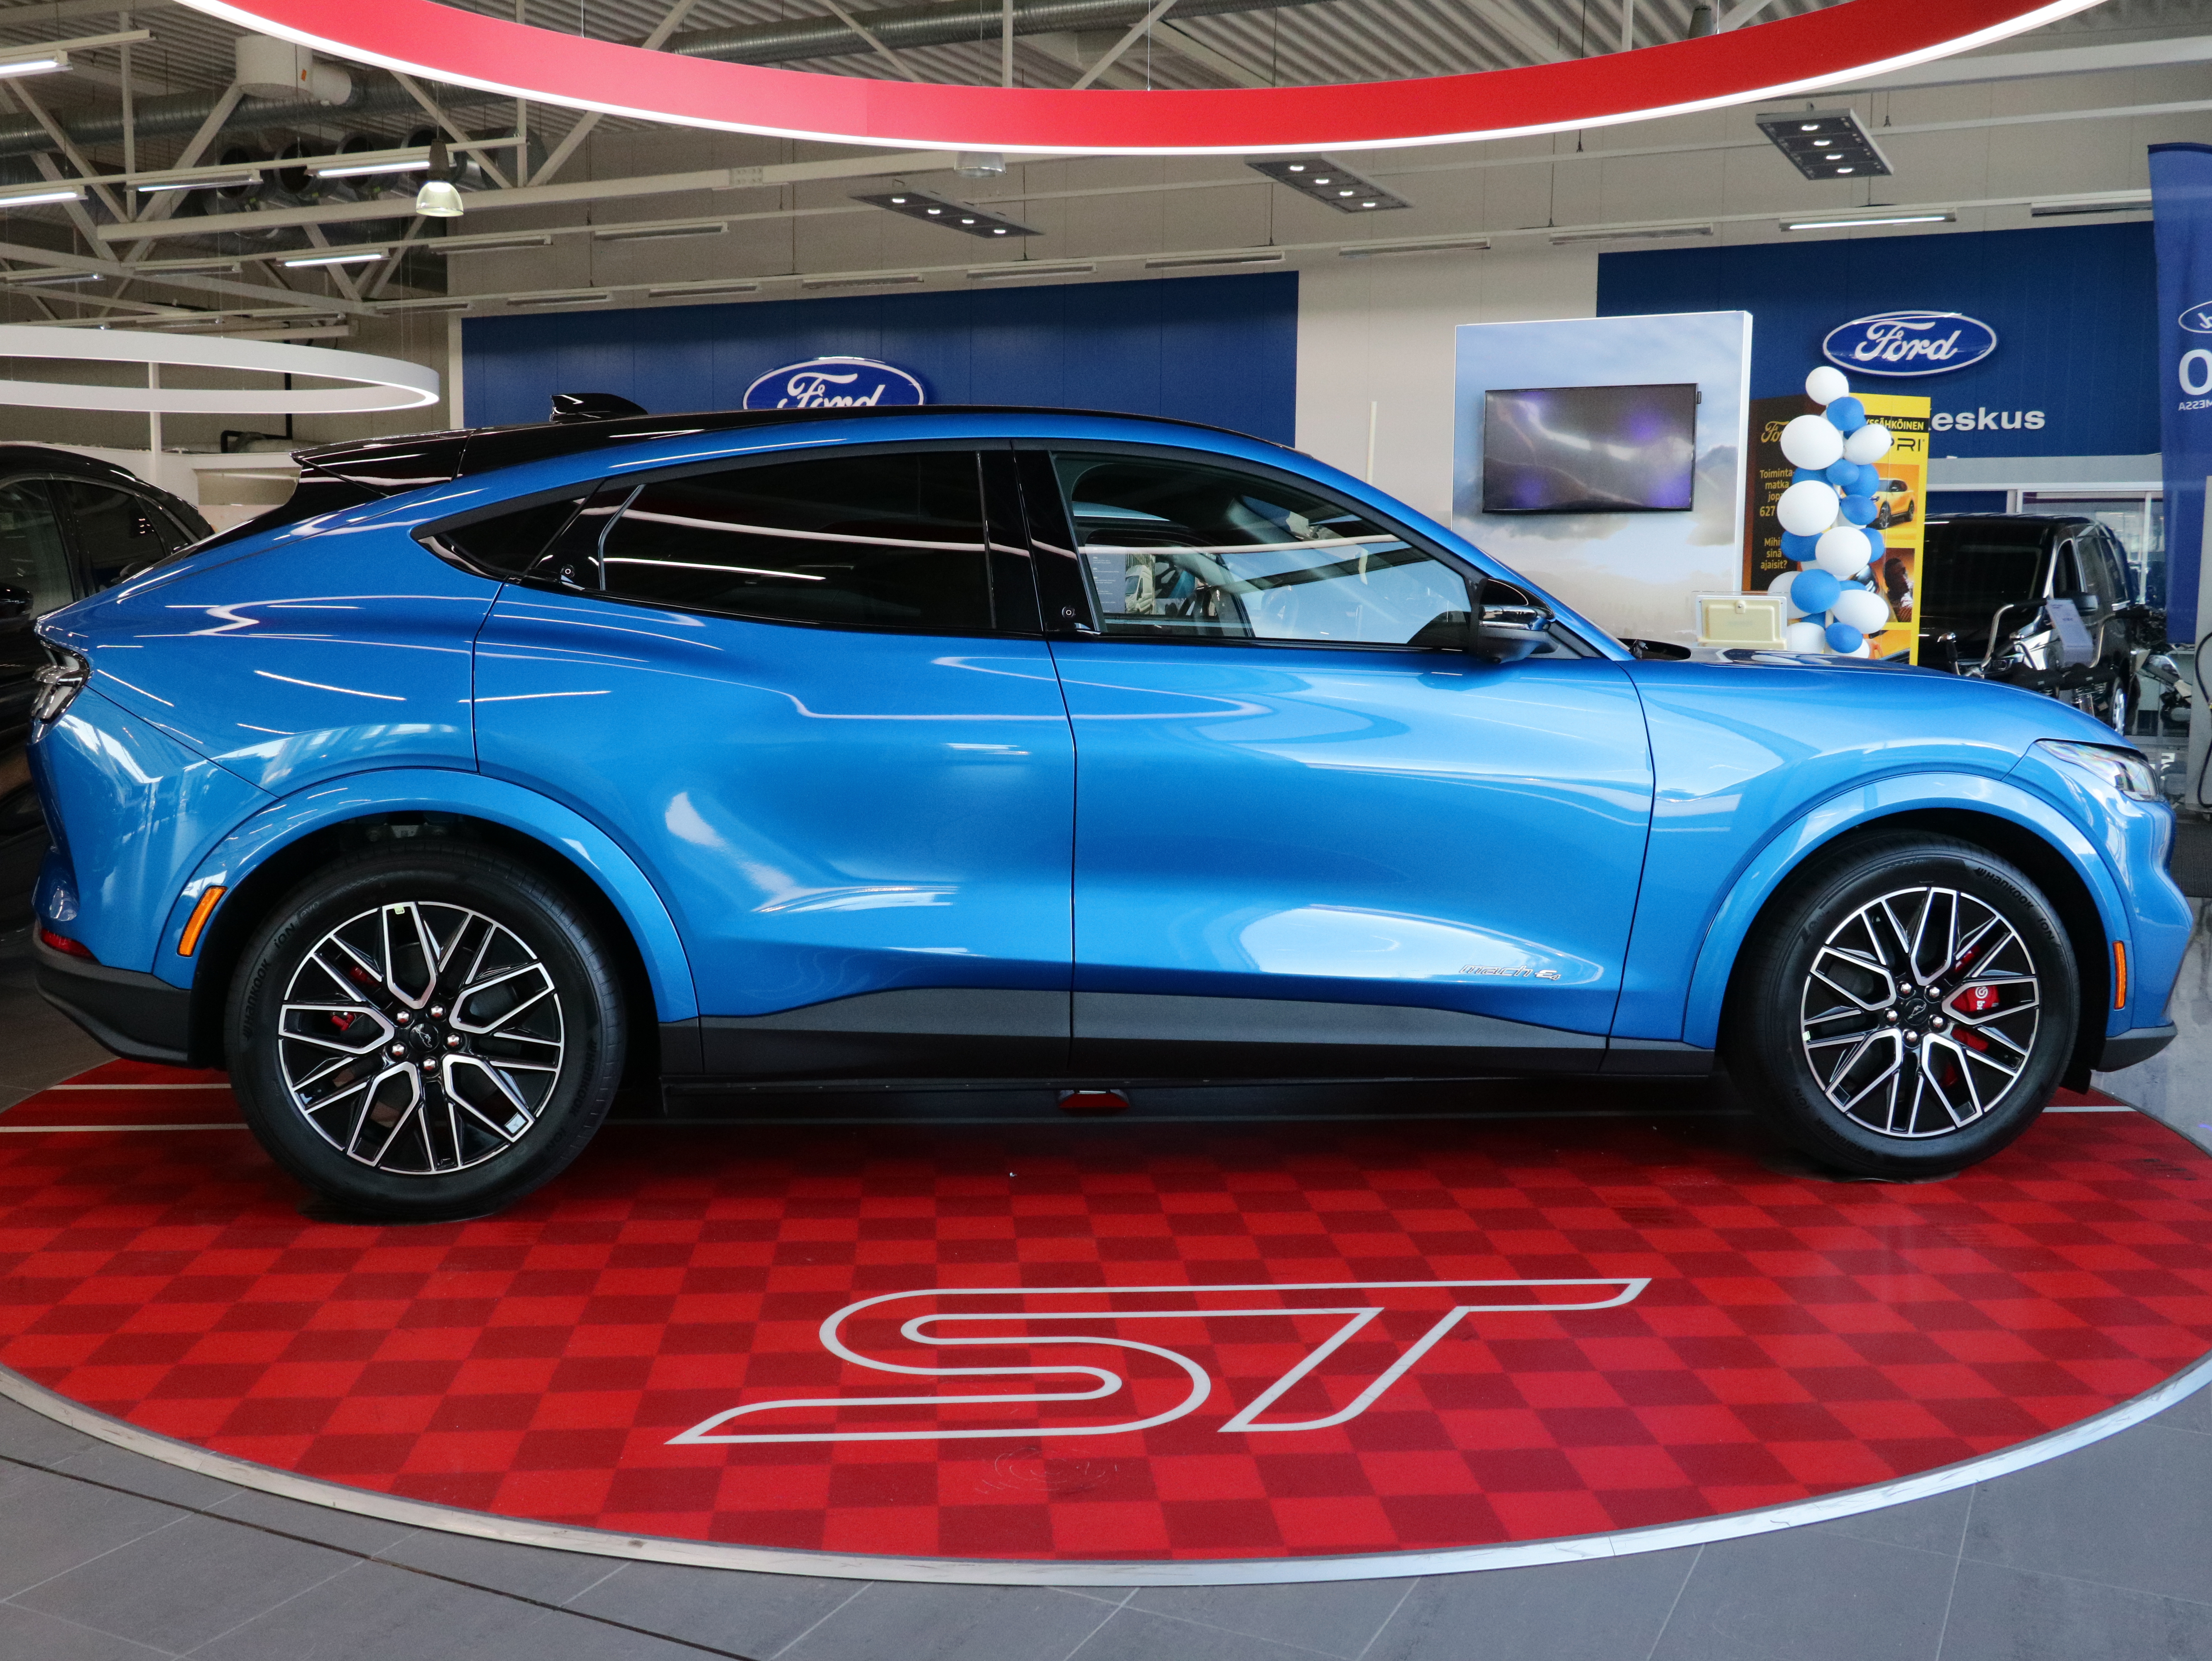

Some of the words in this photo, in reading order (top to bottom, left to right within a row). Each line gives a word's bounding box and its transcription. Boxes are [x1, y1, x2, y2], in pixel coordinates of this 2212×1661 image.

[1855, 321, 1962, 361] Ford
[1928, 407, 2046, 431] eskus
[1761, 421, 1790, 443] Fo
[1759, 468, 1794, 479] Toiminta-
[1765, 480, 1789, 490] matka
[1767, 491, 1784, 502] jop
[1759, 506, 1776, 517] 627
[1764, 537, 1782, 546] Mihi
[1766, 548, 1782, 557] sinä
[1761, 559, 1788, 571] ajaisit?
[663, 1277, 1652, 1445] ST
